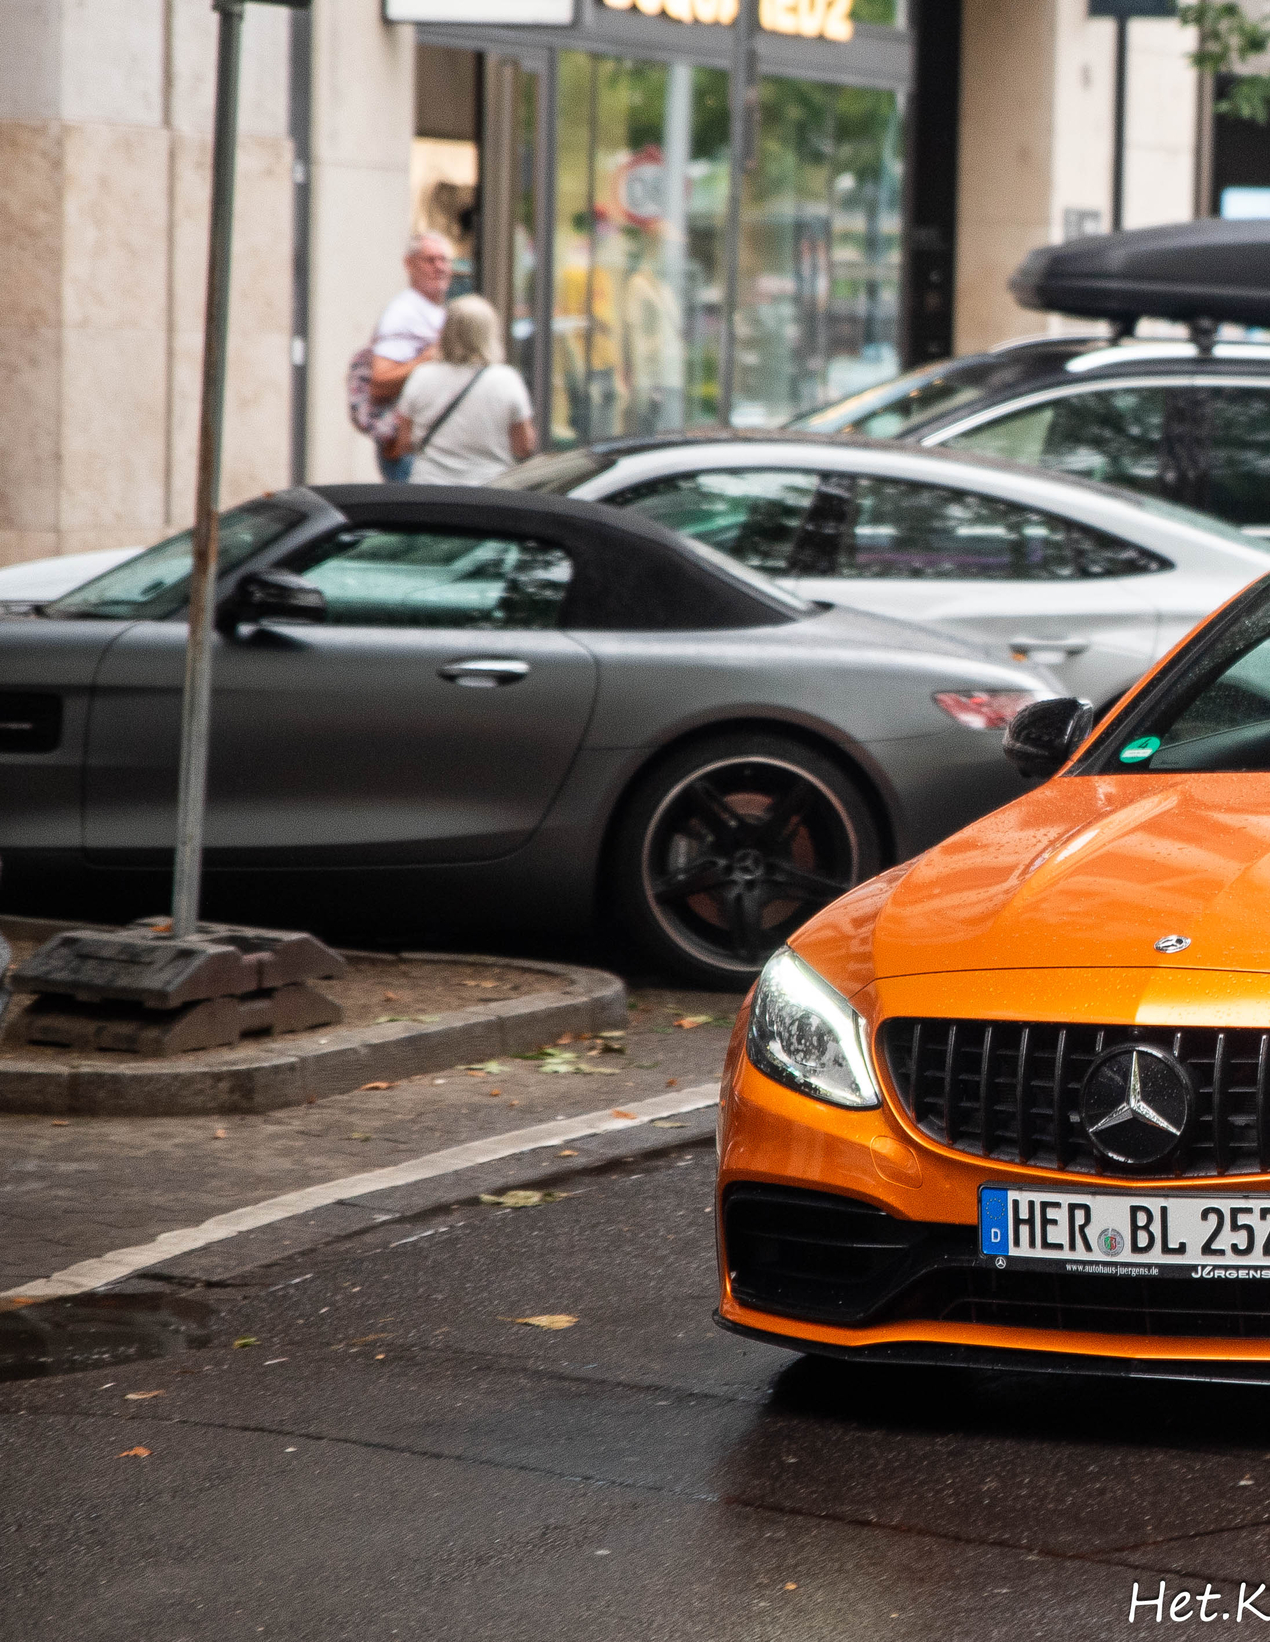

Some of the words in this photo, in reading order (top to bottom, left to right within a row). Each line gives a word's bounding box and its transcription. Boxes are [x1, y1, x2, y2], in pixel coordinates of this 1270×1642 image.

[1012, 1198, 1093, 1253] HER
[1129, 1204, 1187, 1256] BL
[991, 1228, 1001, 1243] D
[1066, 1263, 1159, 1276] www.autohaus-juergens.de
